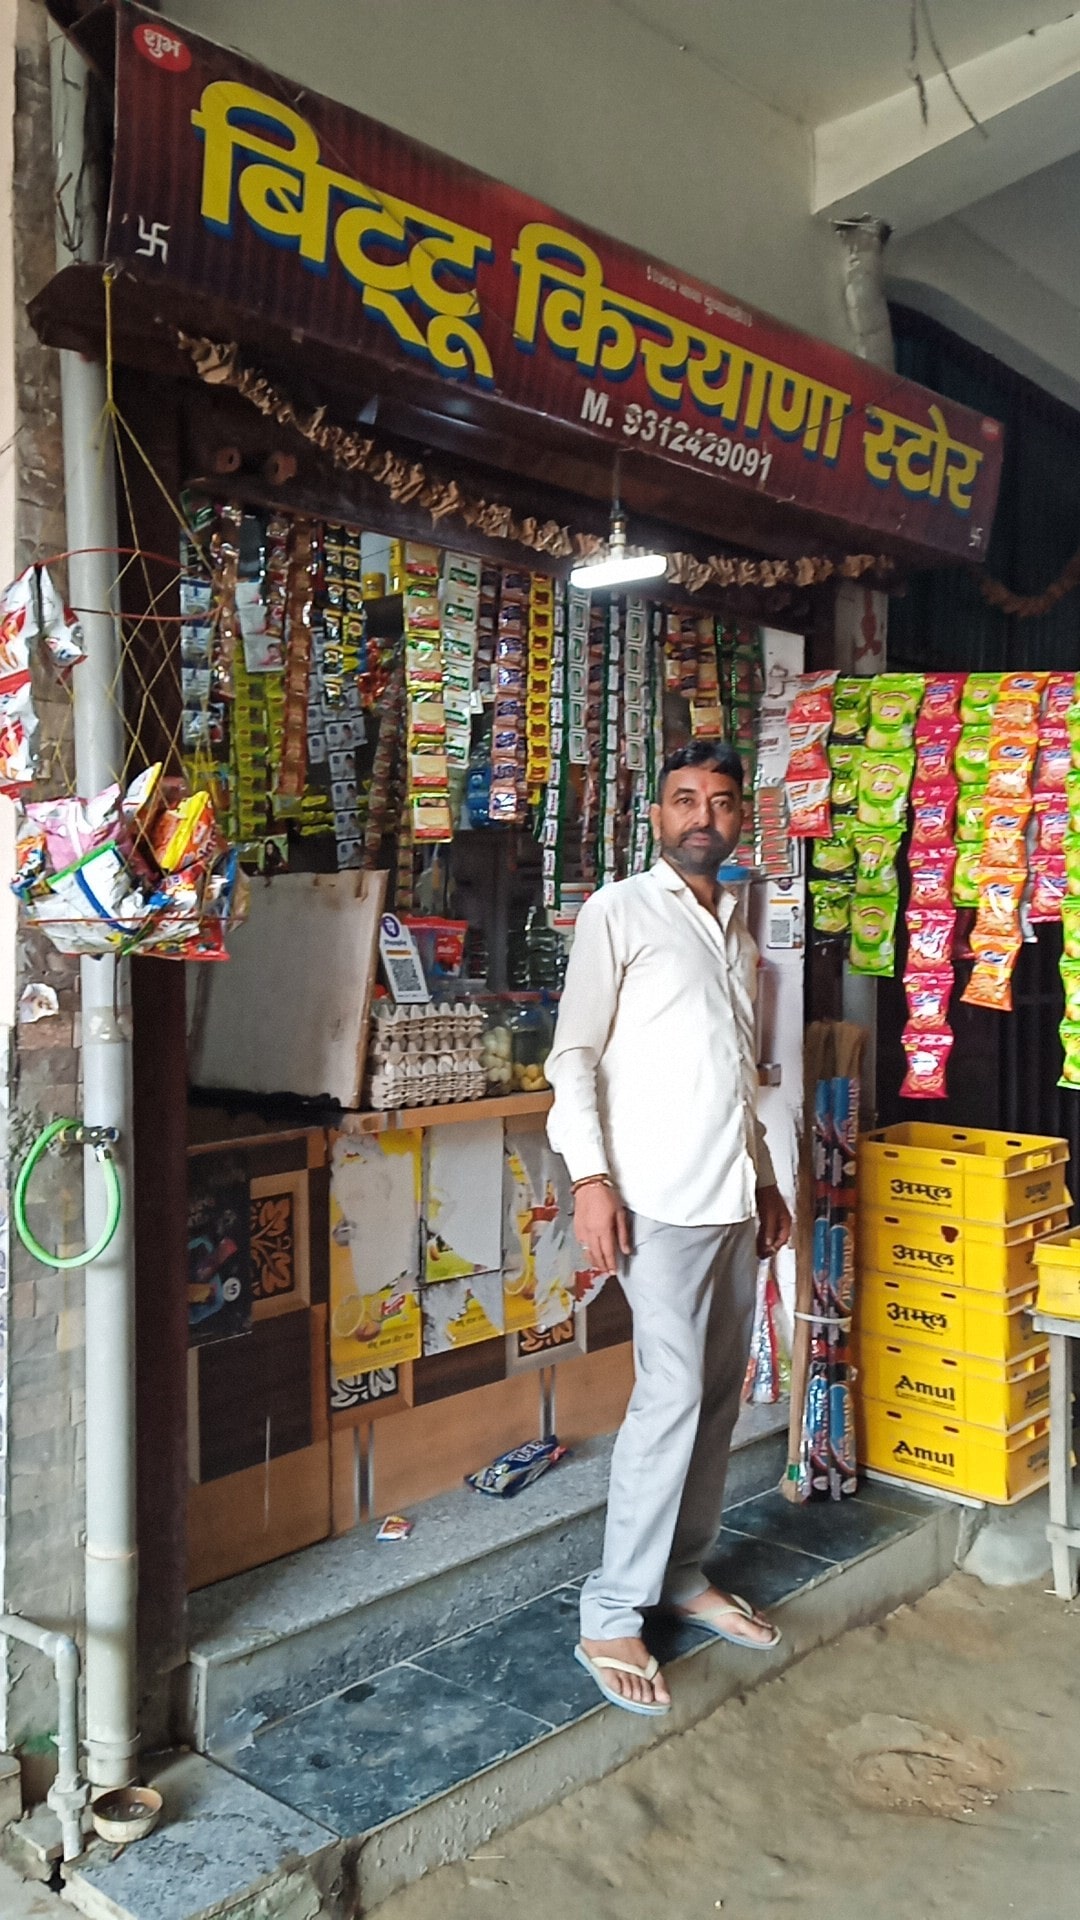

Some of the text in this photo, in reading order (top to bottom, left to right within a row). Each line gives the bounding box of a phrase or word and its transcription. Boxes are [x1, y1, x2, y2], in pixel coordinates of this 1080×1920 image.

[144, 29, 181, 58] शुभ
[191, 81, 984, 515] बिट्टू किरयाणा स्टोर
[581, 388, 773, 481] M. 9312429091
[894, 1375, 956, 1401] Amul
[892, 1440, 955, 1467] Amul
